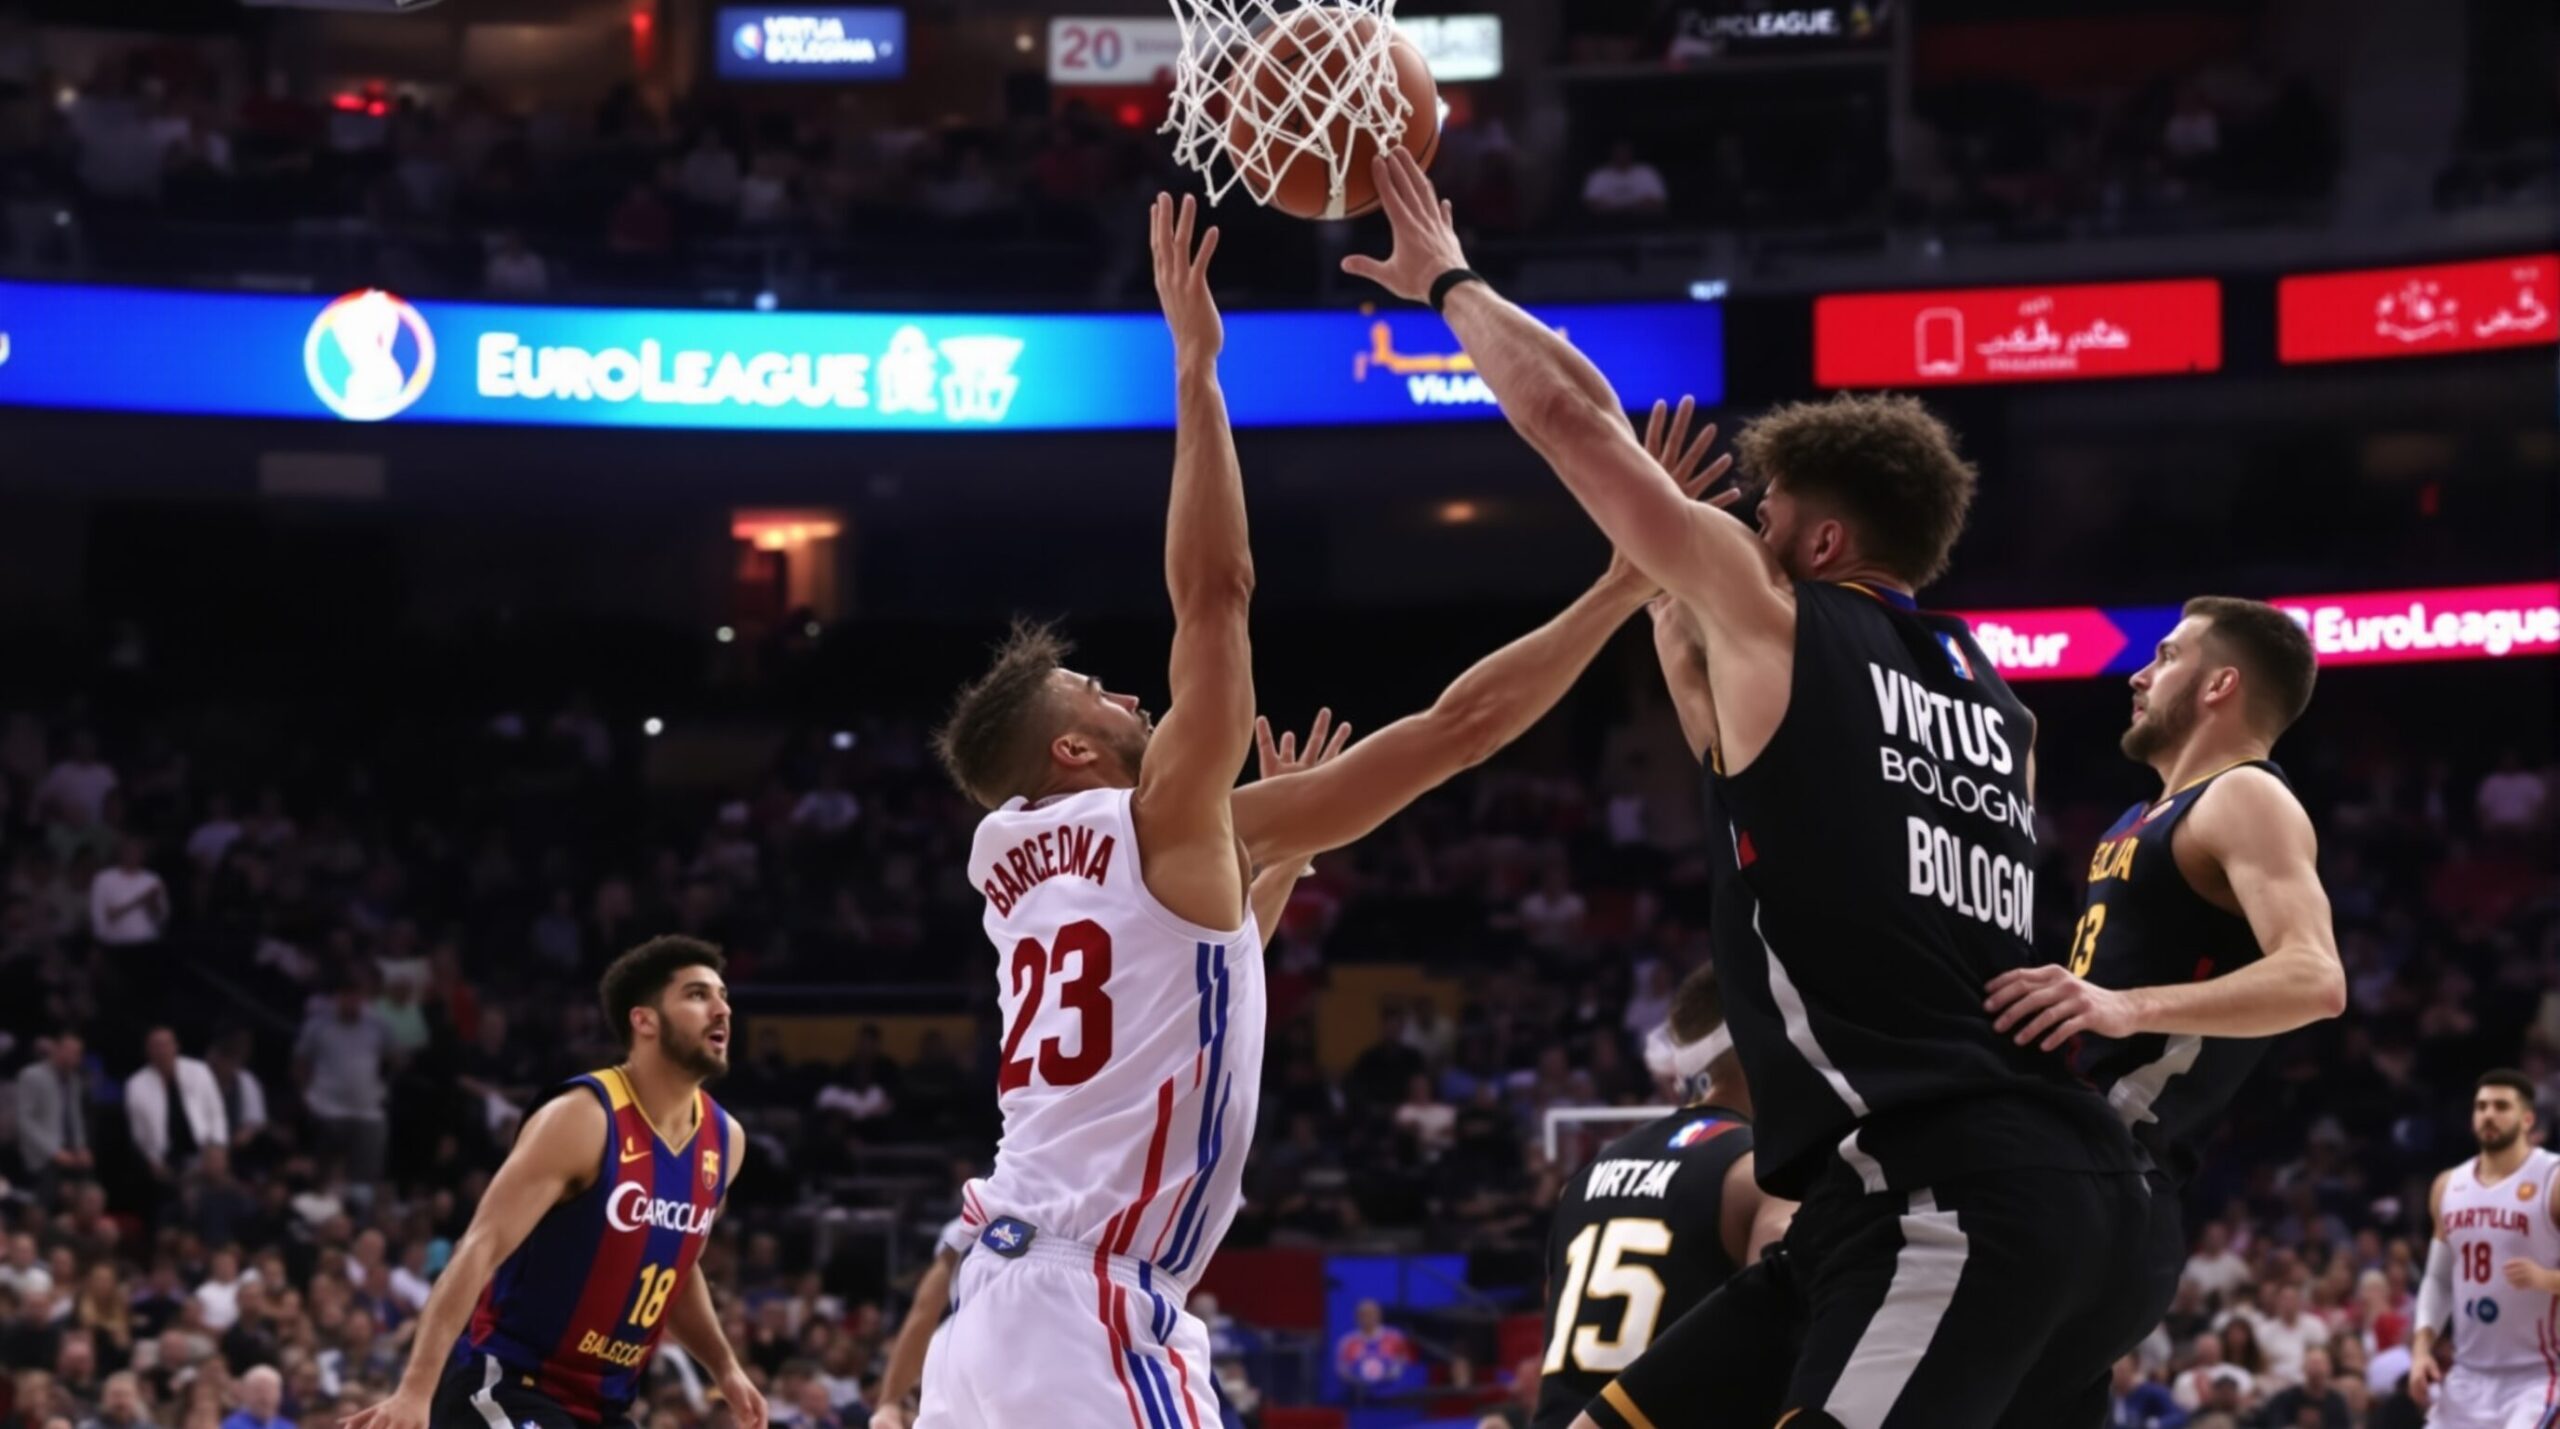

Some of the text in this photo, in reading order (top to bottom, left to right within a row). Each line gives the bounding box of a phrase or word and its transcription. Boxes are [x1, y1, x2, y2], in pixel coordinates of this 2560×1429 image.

[1060, 25, 1122, 70] 20
[2313, 603, 2560, 656] EuroLeague
[1869, 662, 2013, 775] VIRTUS
[1000, 919, 1112, 1096] 23
[628, 1262, 677, 1329] 18
[2461, 1241, 2492, 1284] 18
[1541, 1217, 1674, 1376] 15
